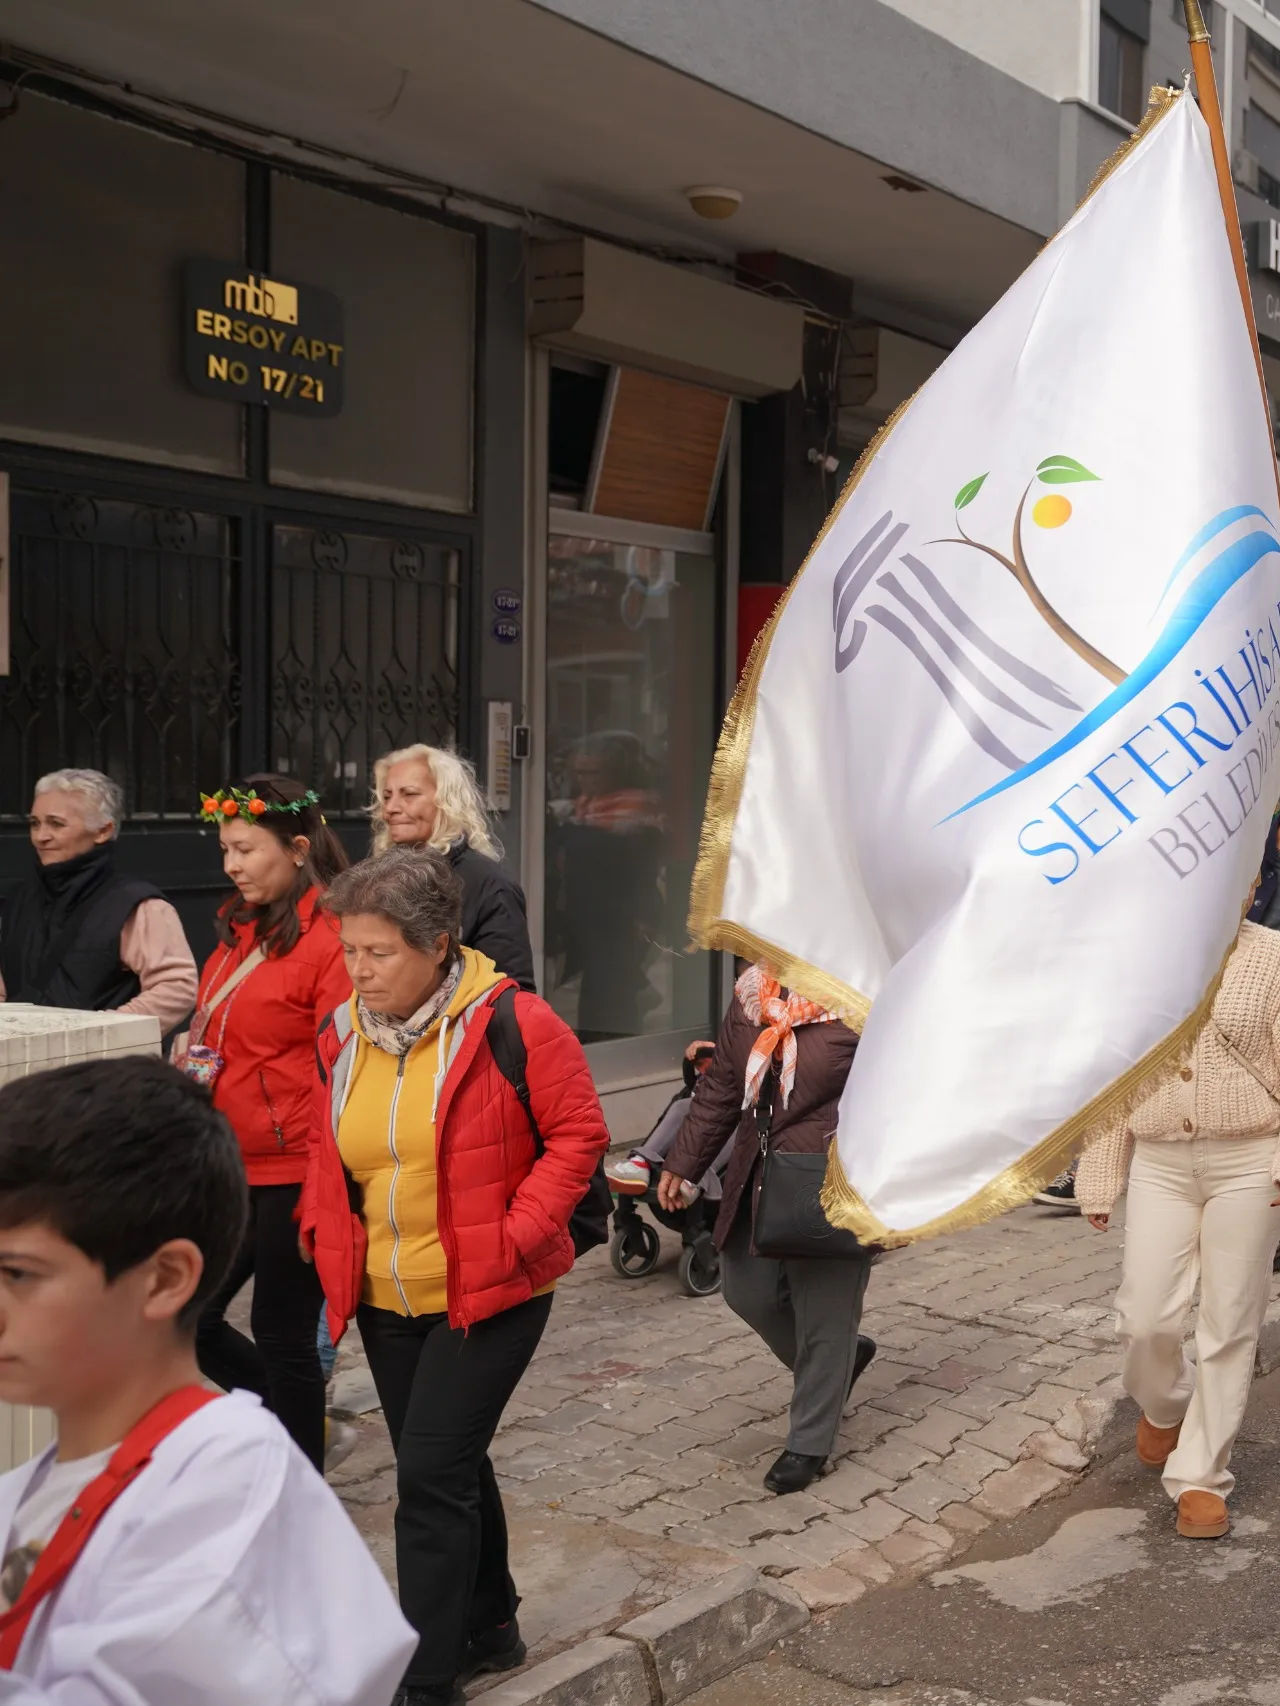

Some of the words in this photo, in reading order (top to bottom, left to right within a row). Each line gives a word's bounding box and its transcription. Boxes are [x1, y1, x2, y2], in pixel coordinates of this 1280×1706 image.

[197, 308, 286, 353] ERSOY
[291, 335, 343, 367] APT
[208, 354, 248, 385] NO
[260, 366, 323, 402] 17/21
